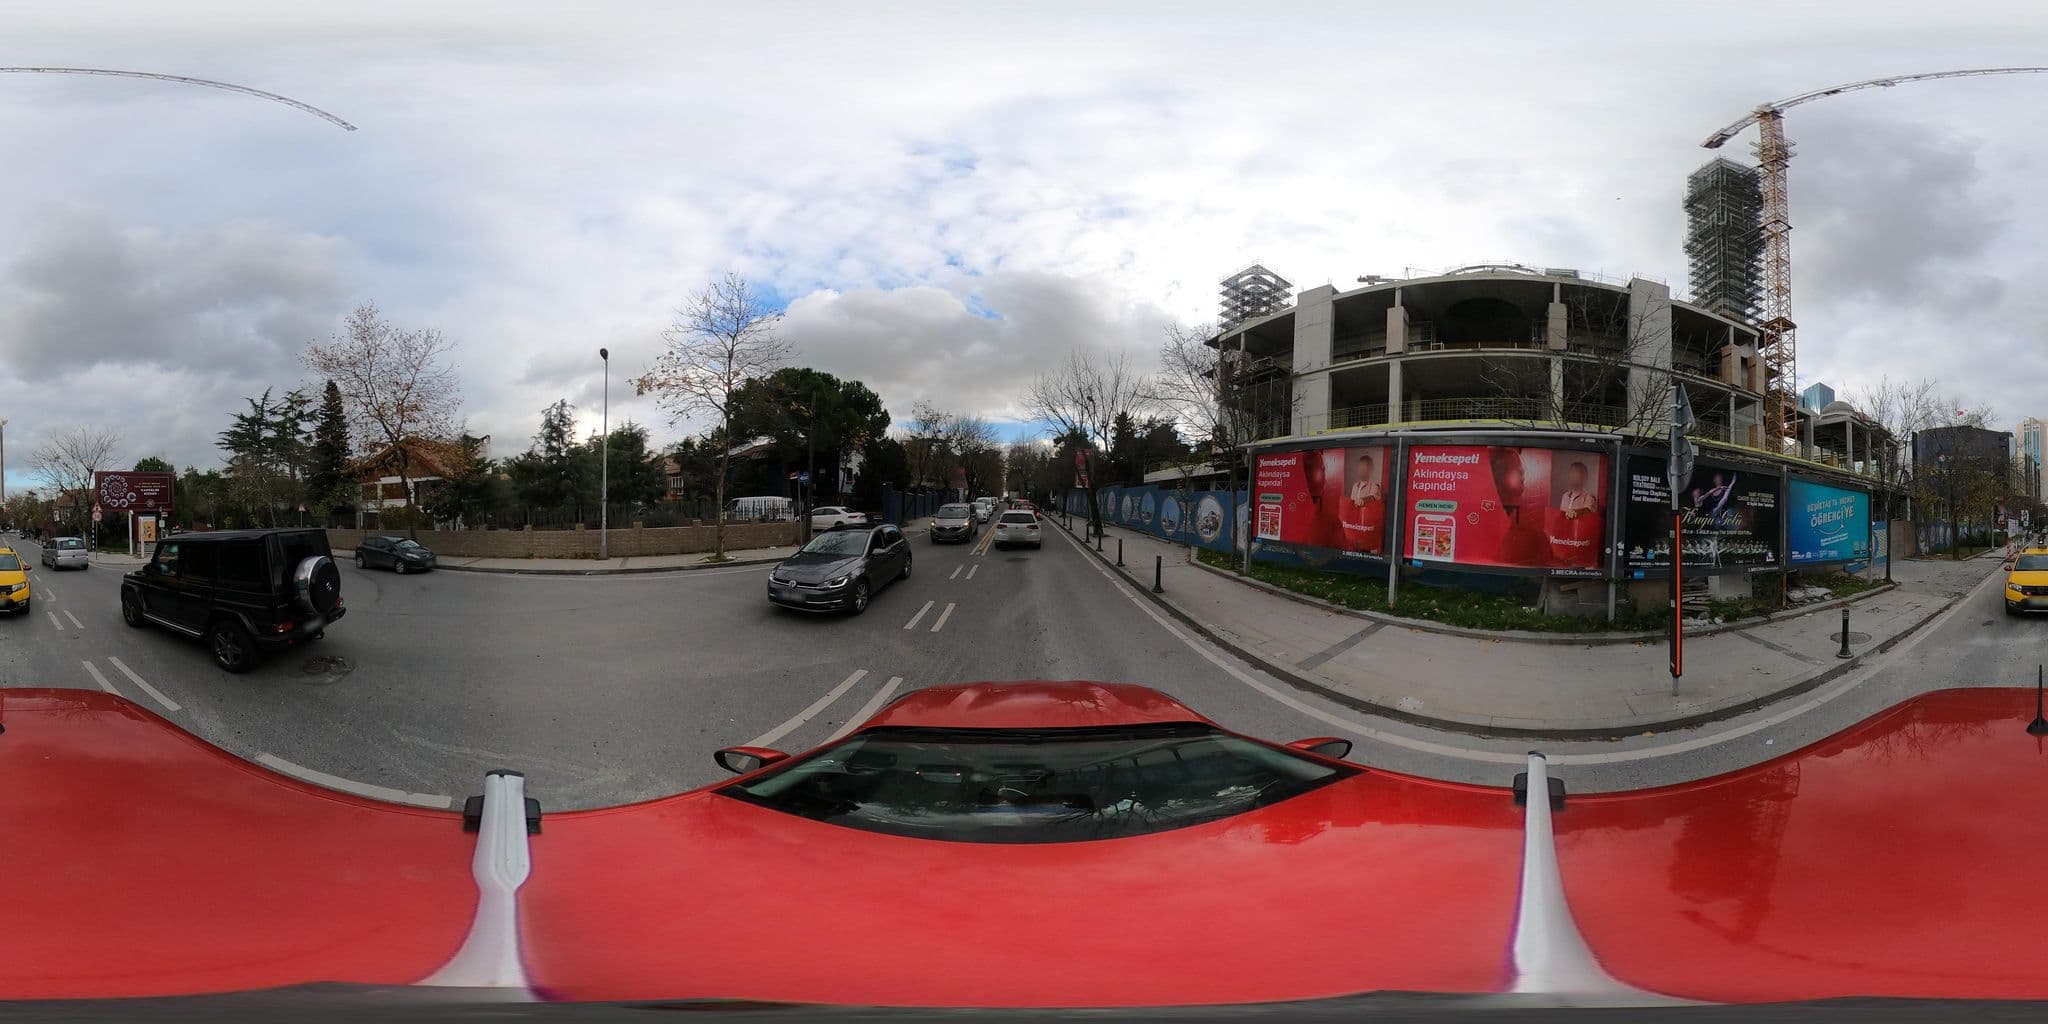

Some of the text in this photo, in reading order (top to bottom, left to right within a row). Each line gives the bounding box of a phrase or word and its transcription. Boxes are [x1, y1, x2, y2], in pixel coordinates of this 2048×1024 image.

[1259, 457, 1297, 468] Yemeksepeti
[1414, 452, 1480, 466] Yemeksepeti
[1413, 469, 1469, 481] Aklındaysa
[1412, 480, 1456, 492] kapında!
[1681, 506, 1744, 530] Kuğu Gölü
